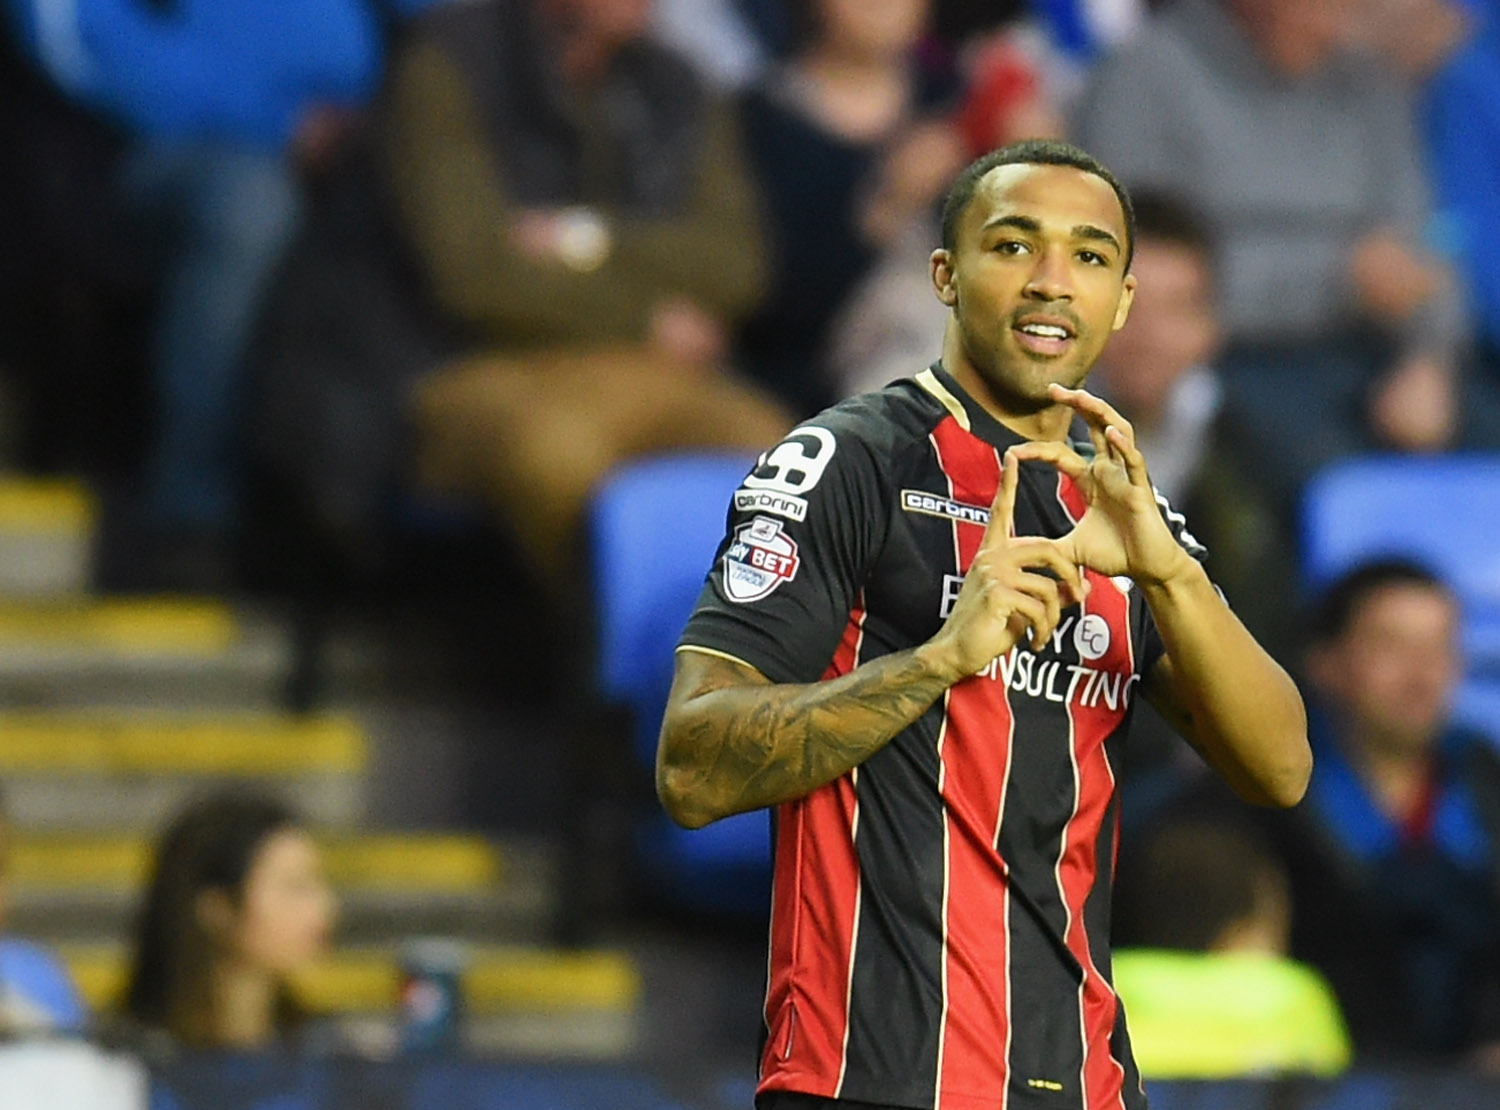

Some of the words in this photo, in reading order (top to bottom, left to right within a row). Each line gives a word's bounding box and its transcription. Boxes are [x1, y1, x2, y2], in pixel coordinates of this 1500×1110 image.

[737, 494, 803, 516] carbrini
[907, 494, 991, 522] carbrin
[752, 548, 792, 575] BET
[976, 644, 1141, 712] NSULTIN
